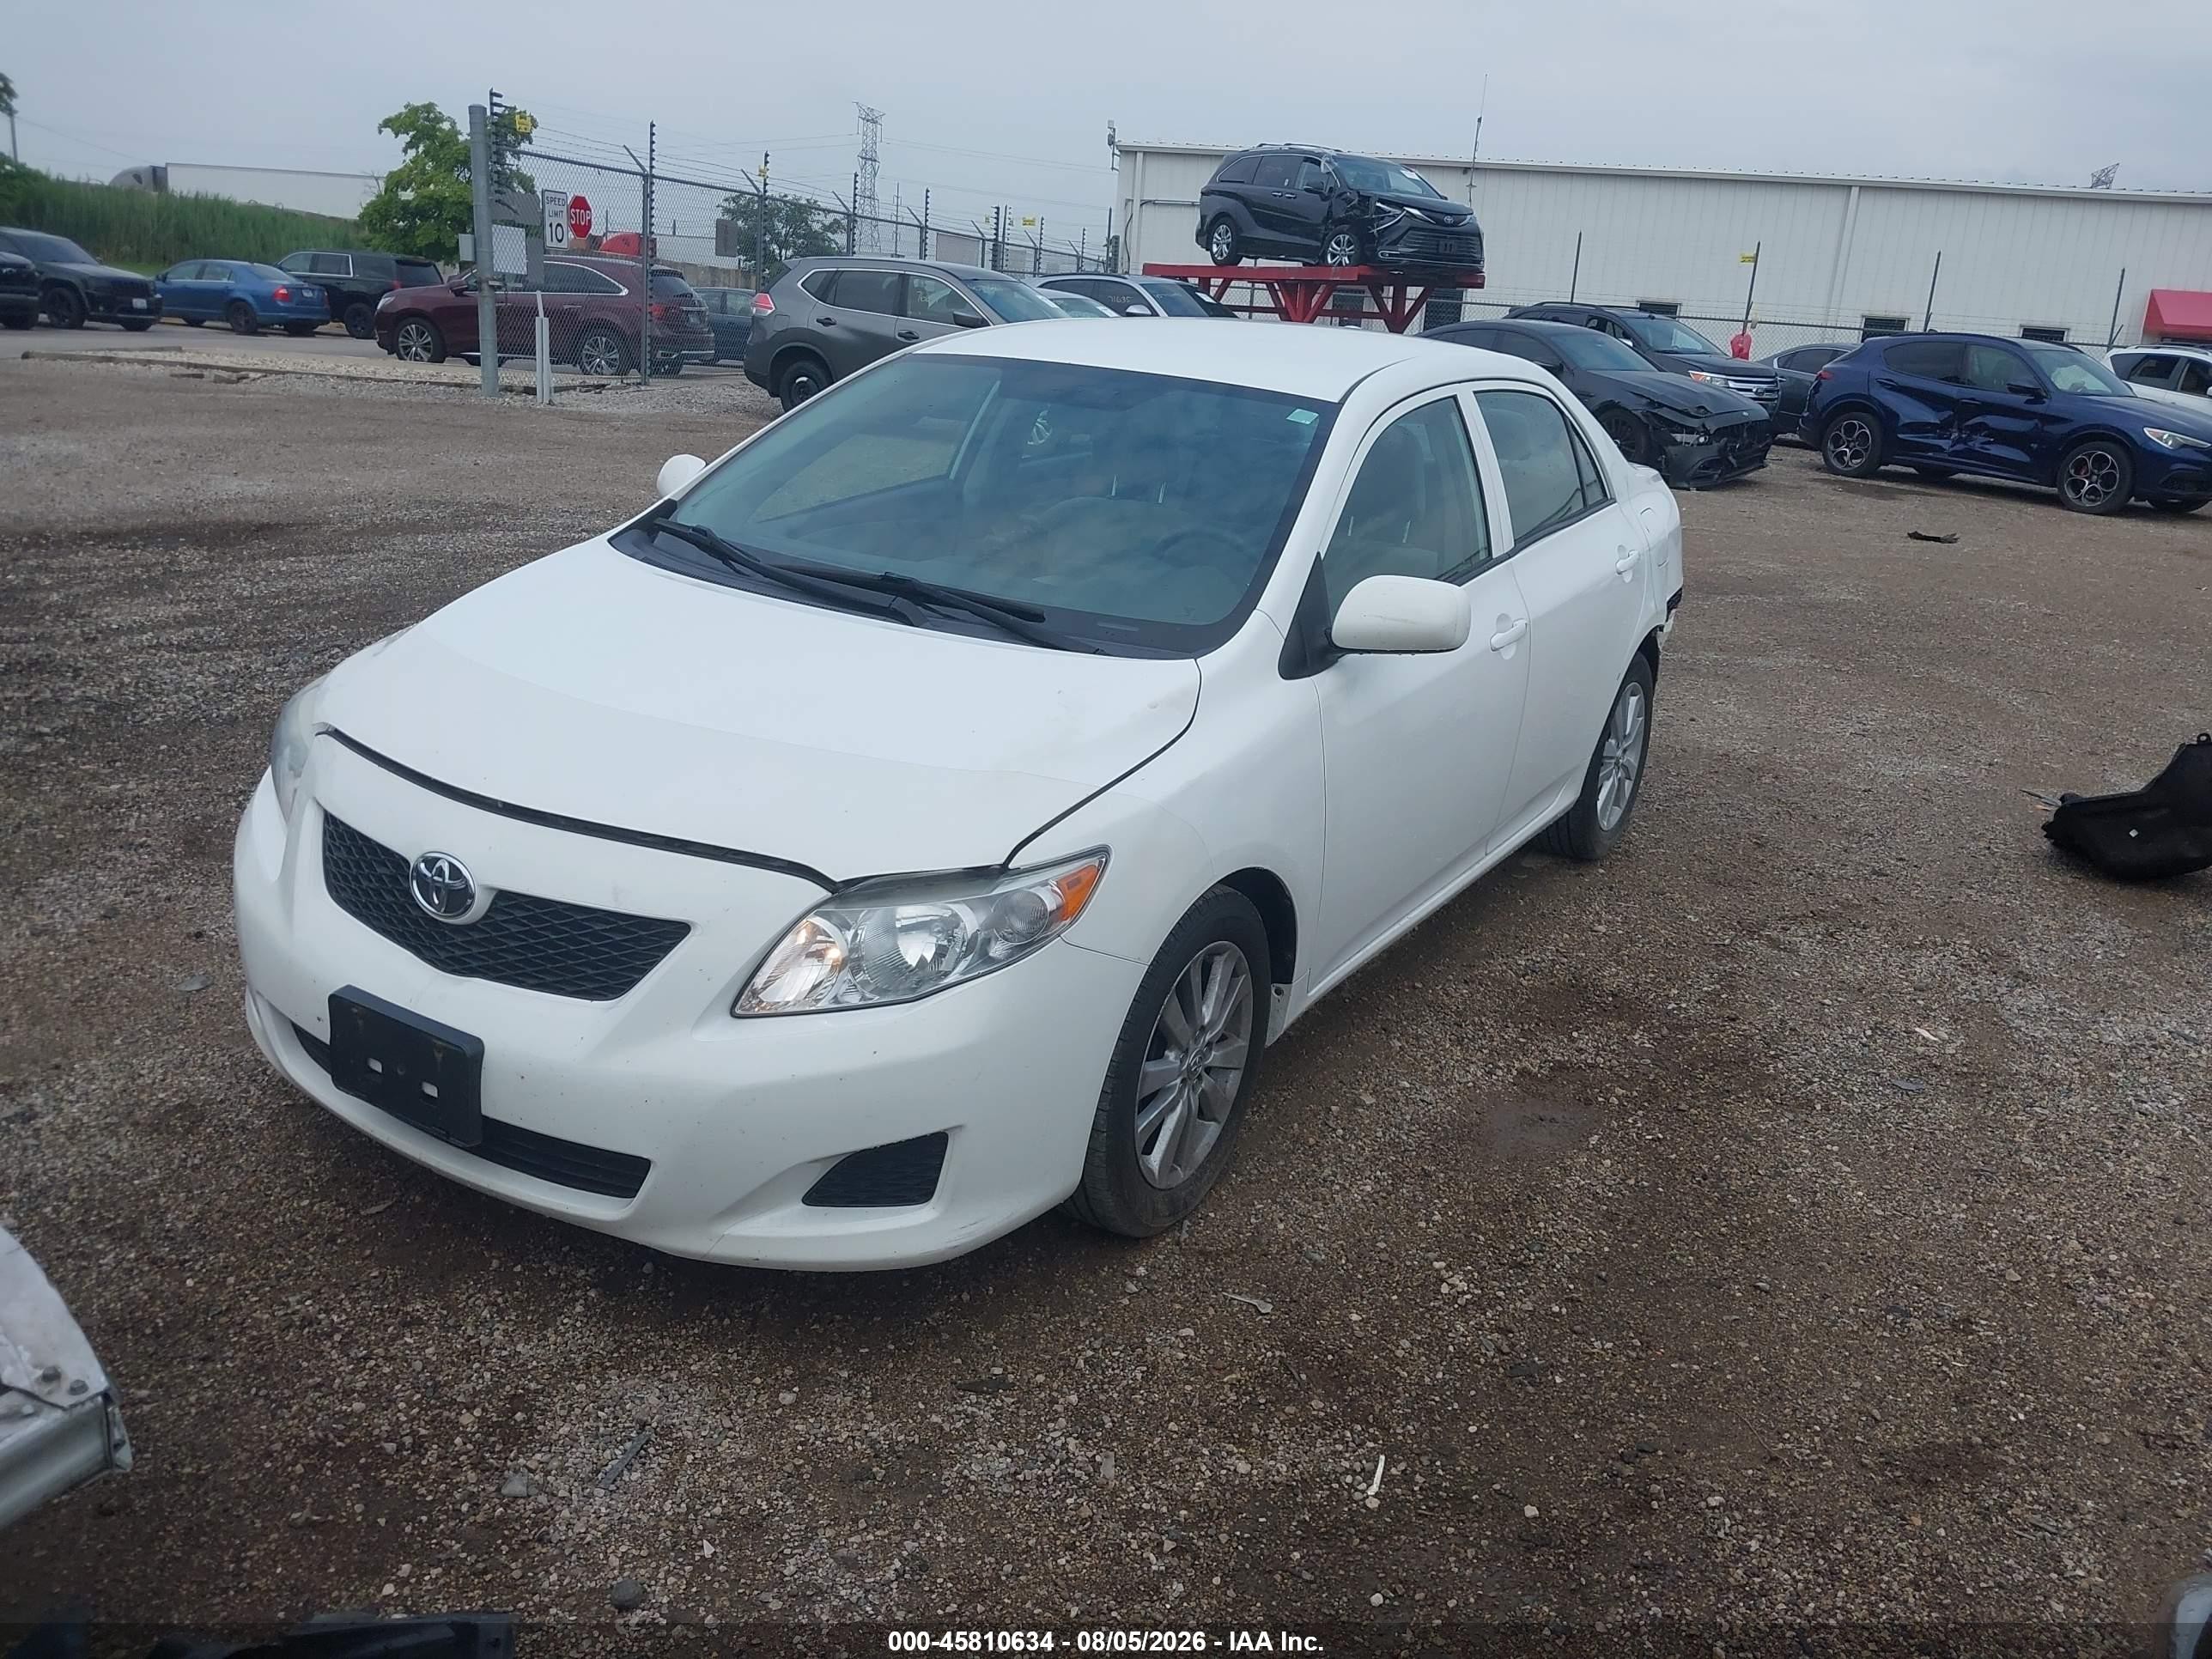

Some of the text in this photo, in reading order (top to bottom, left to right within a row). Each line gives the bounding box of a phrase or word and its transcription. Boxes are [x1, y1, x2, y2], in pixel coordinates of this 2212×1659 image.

[545, 196, 566, 207] SPEED
[548, 209, 564, 219] LIMIT
[570, 209, 591, 226] STOP
[549, 222, 564, 243] 10
